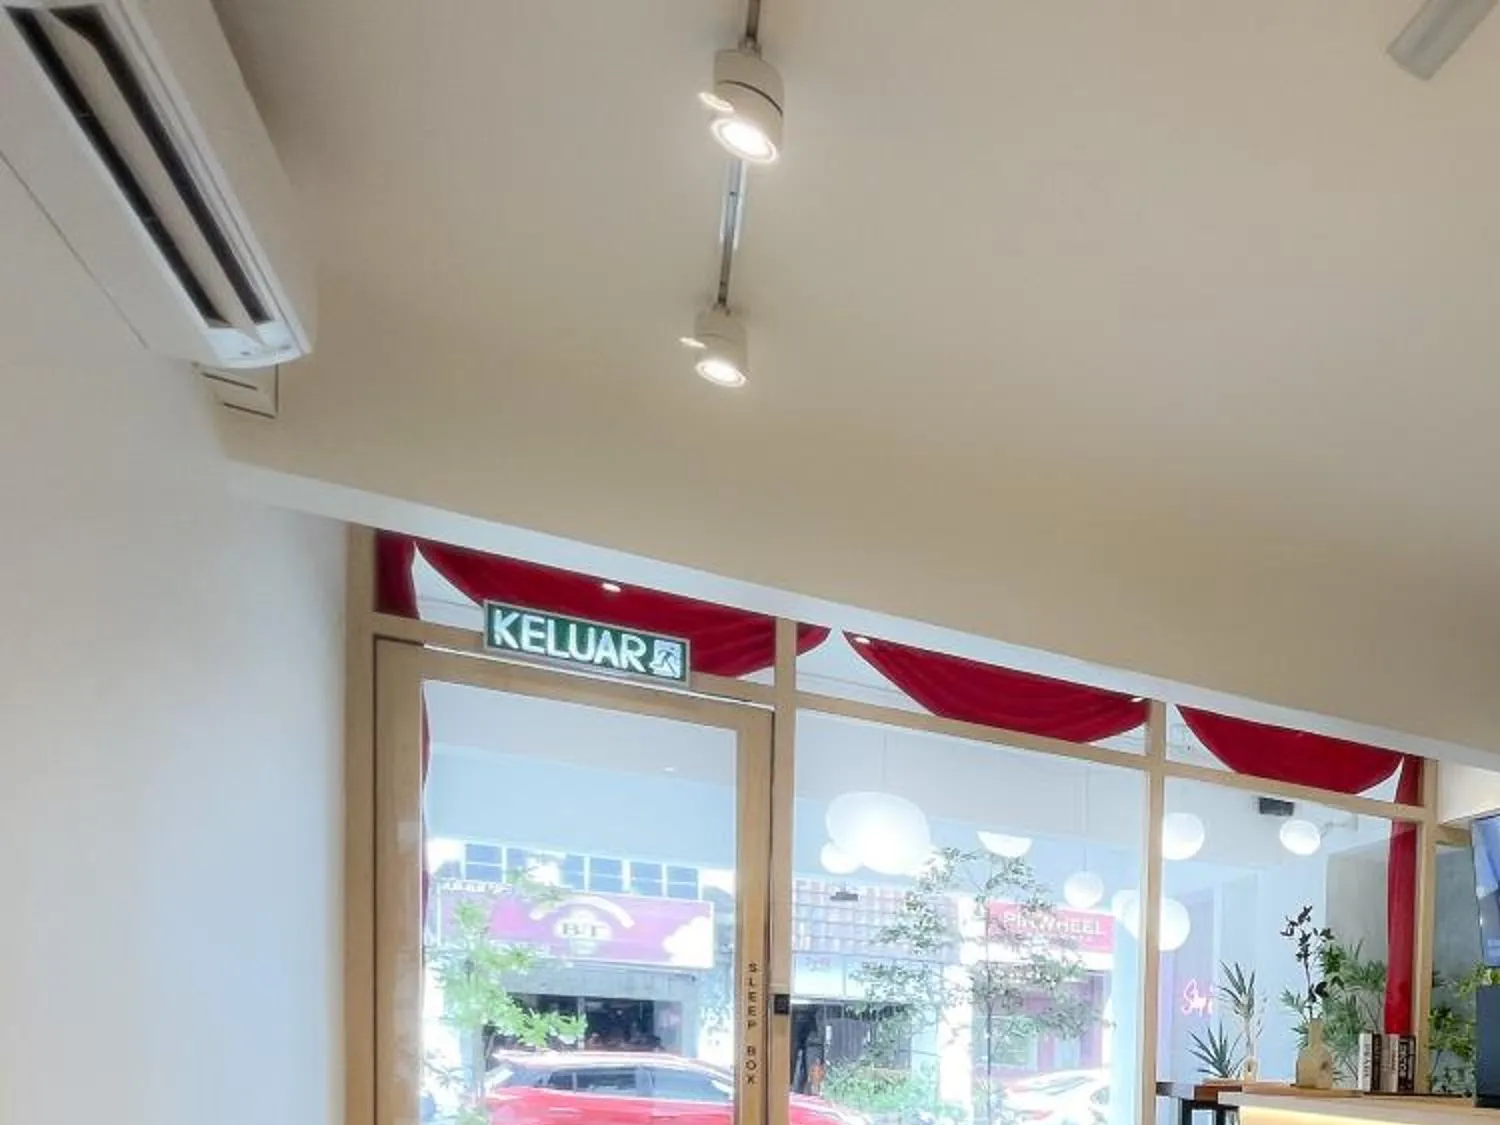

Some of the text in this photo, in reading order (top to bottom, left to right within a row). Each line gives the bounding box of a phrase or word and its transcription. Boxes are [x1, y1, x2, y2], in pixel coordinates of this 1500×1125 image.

[493, 608, 647, 673] KELUAR
[745, 961, 759, 1085] SLEEP BOX
